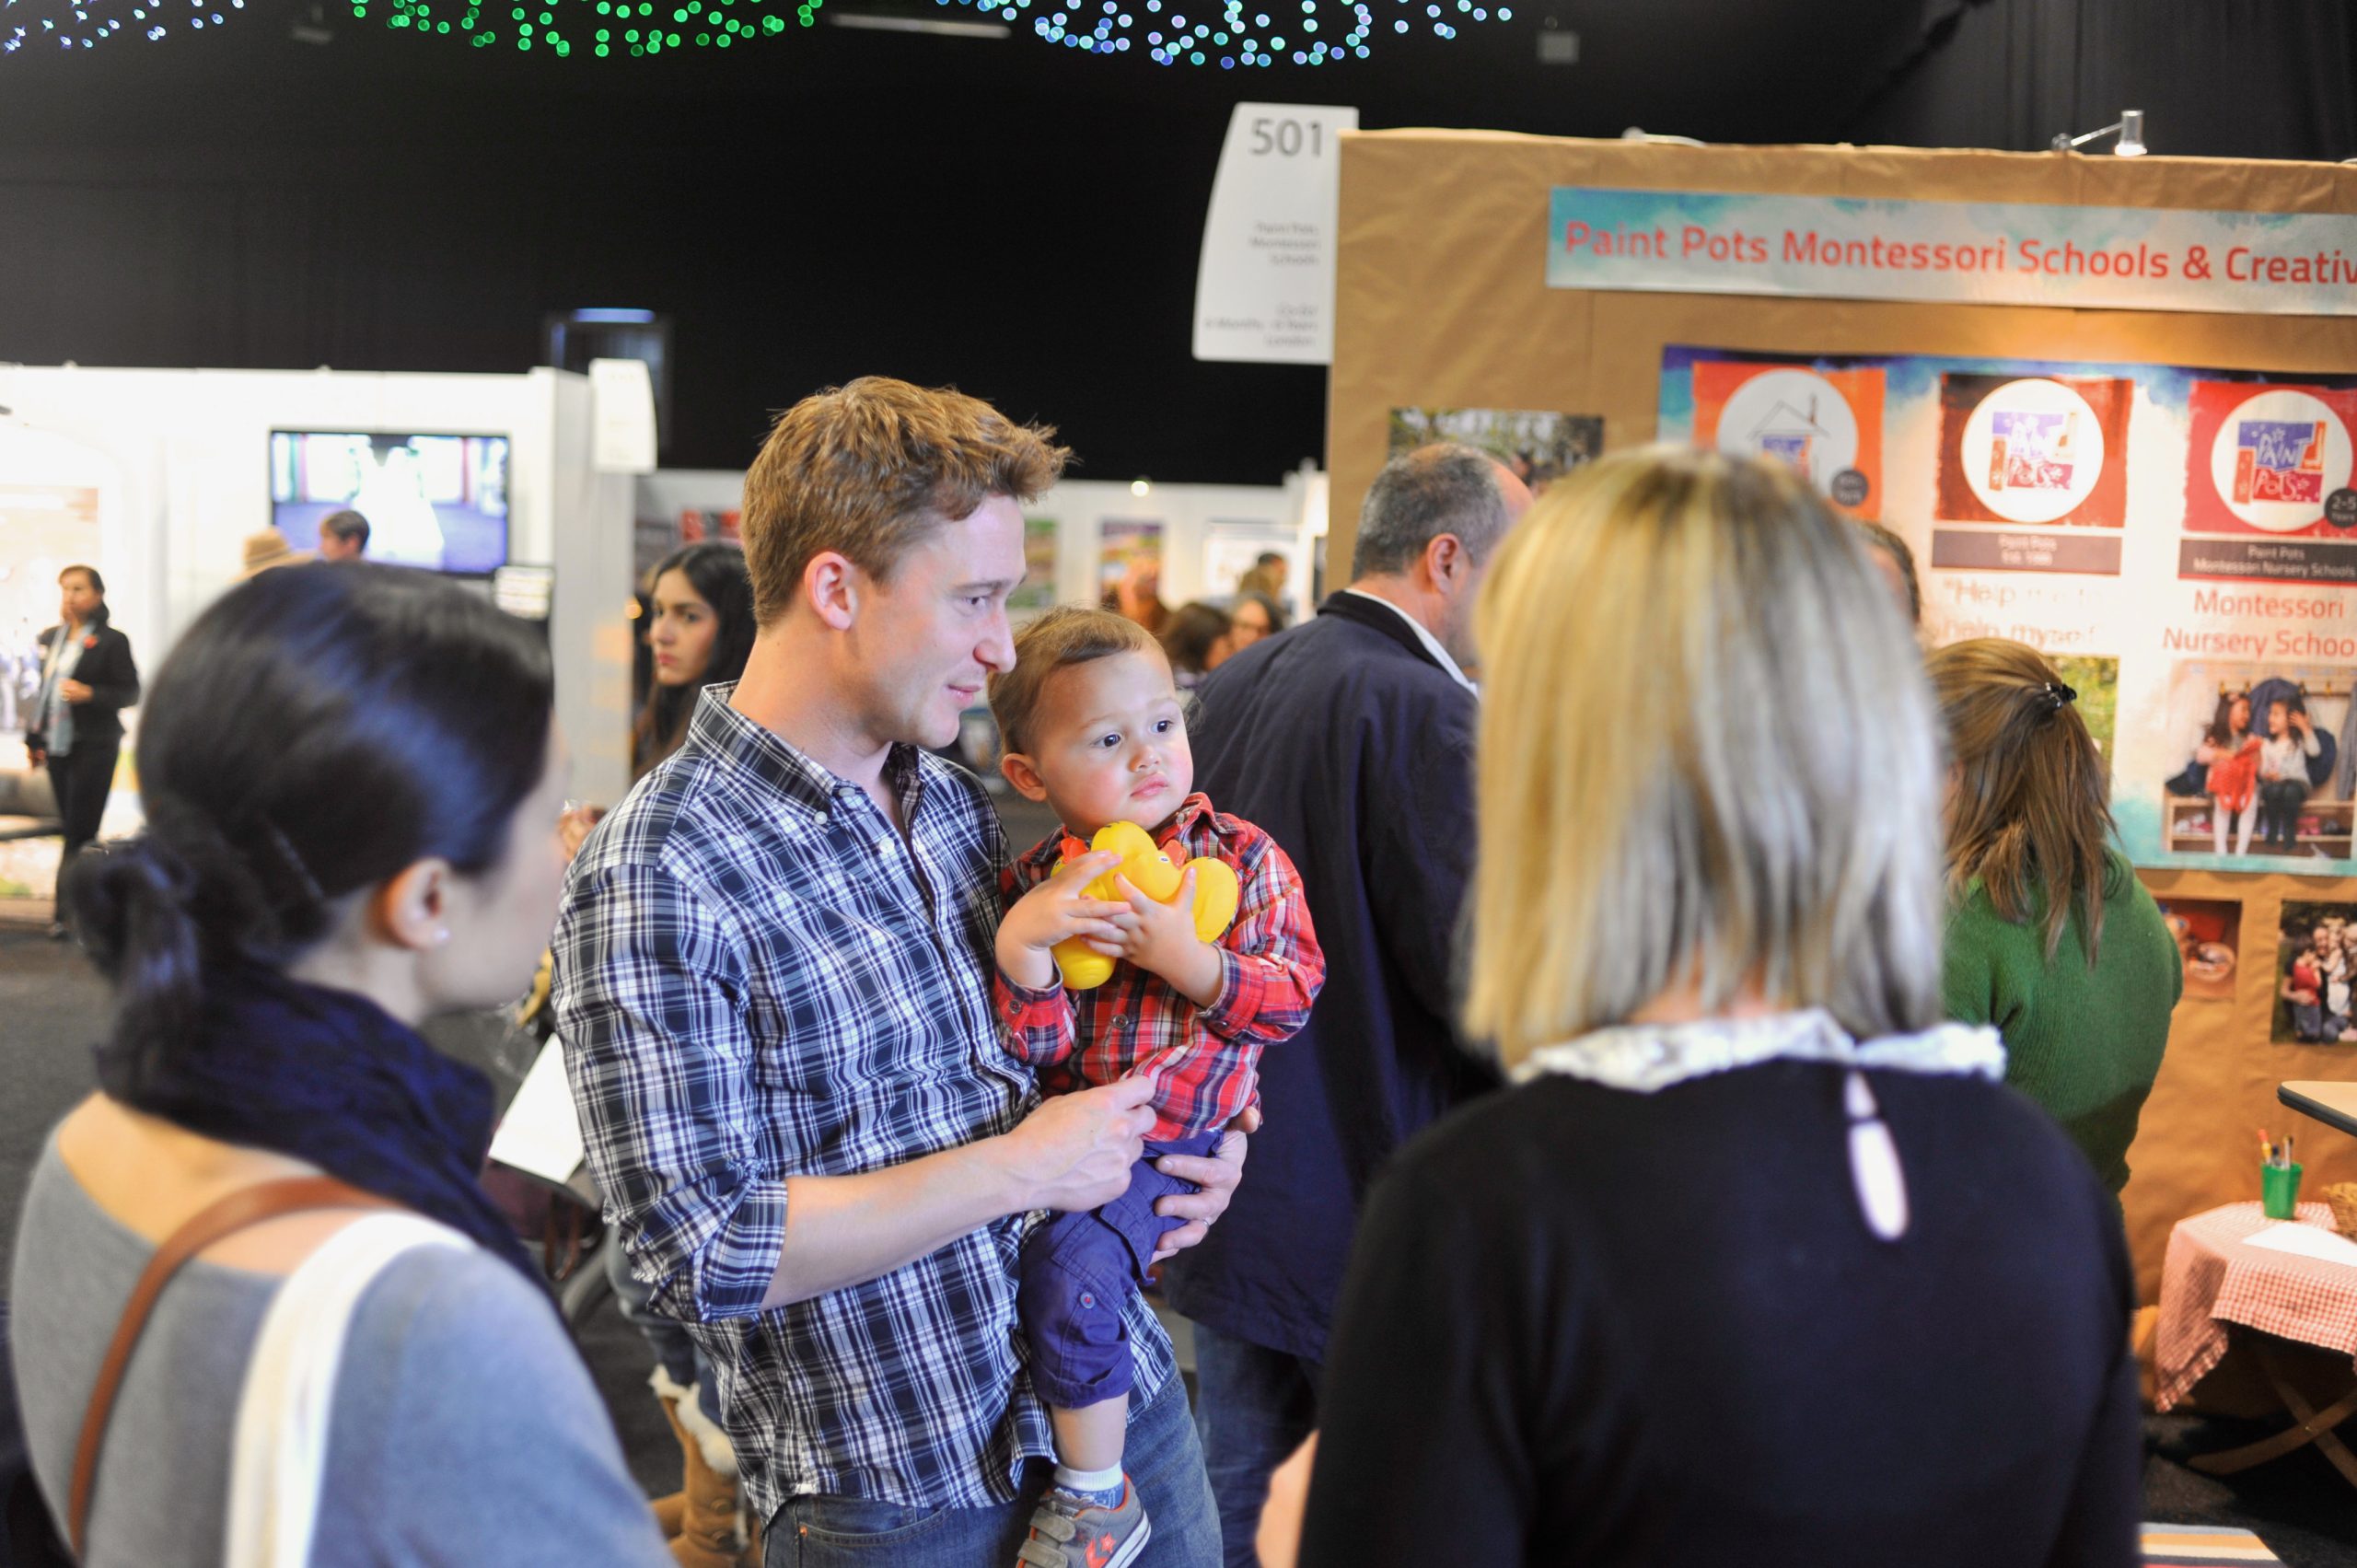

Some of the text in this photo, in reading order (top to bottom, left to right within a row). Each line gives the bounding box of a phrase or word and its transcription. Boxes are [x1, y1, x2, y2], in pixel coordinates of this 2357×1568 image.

[1248, 117, 1322, 157] 501
[1565, 220, 2357, 285] Paint Pots Montessori Schools & Creativ
[2258, 433, 2313, 468] PAINT
[2194, 589, 2344, 620] Montessori
[2164, 627, 2355, 663] Nursery Schoo
